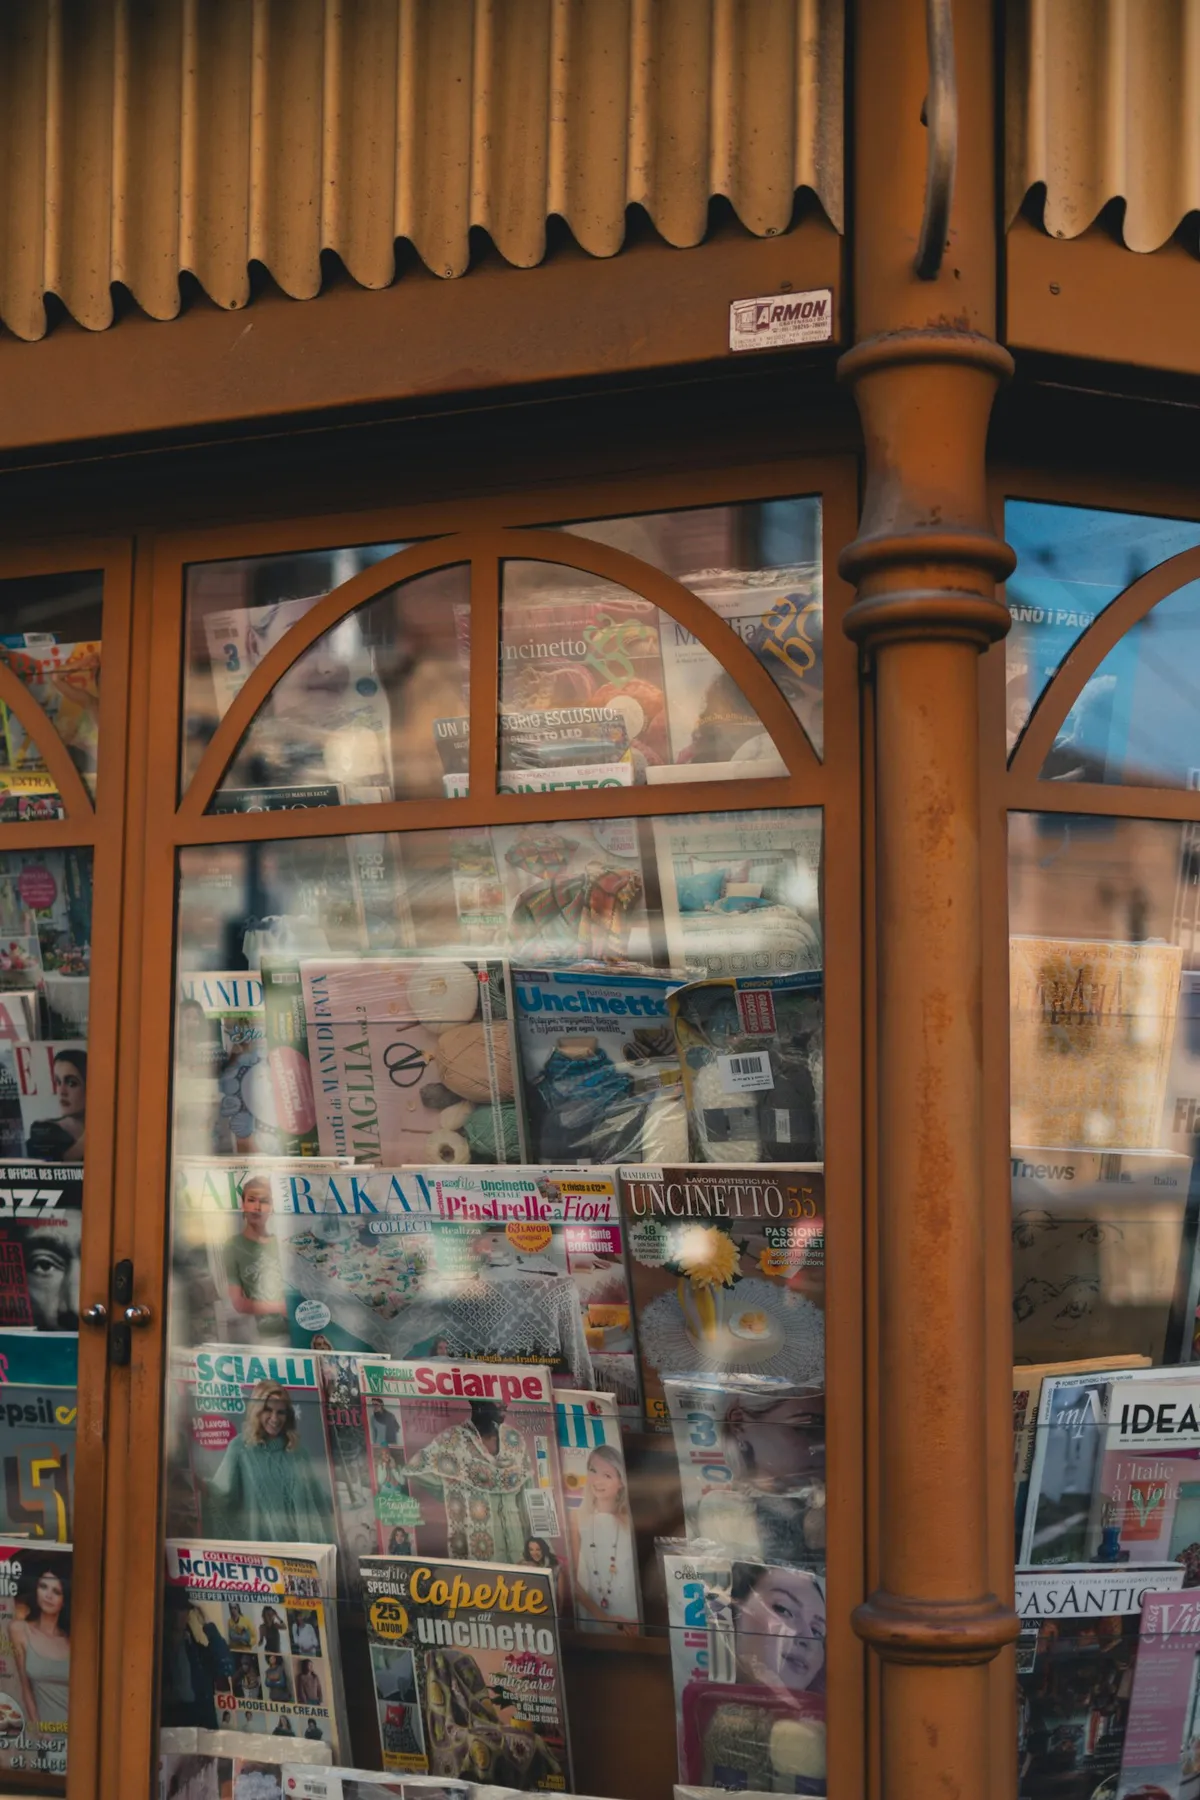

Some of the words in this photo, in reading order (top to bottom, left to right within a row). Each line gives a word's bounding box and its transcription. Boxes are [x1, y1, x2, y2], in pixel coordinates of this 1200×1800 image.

[437, 722, 459, 738] UN
[310, 973, 332, 1018] FATA
[317, 1046, 340, 1093] MANI
[342, 1038, 384, 1166] MAGLIA
[8, 1167, 38, 1180] OFFICIEL
[38, 1168, 53, 1181] DES
[717, 1177, 761, 1185] ARTISTICI
[480, 1180, 536, 1193] Uncinetto
[445, 1196, 553, 1223] Piastrelle
[563, 1195, 612, 1223] Fiori
[628, 1183, 784, 1218] UNCINETTO
[787, 1187, 817, 1219] 55
[764, 1226, 824, 1237] PASSIONE
[567, 1241, 615, 1253] BORDURE
[771, 1237, 825, 1249] CROCHET
[195, 1353, 317, 1386] SCIALLI
[197, 1382, 241, 1398] SCIARPE
[414, 1367, 543, 1403] Sciarpe
[196, 1397, 245, 1413] PONCHO
[1115, 1464, 1175, 1481] L'Italie
[1111, 1487, 1122, 1502] à
[203, 1551, 263, 1565] COLLECTION
[187, 1571, 271, 1593] indossato
[367, 1580, 407, 1596] SPECIALE
[206, 1592, 222, 1601] PER
[223, 1593, 250, 1602] TUTTO
[250, 1595, 280, 1604] L'ANNO
[409, 1567, 550, 1619] Coperte
[375, 1602, 401, 1621] 25
[683, 1582, 708, 1628] 2
[375, 1621, 403, 1634] LAVORI
[416, 1616, 556, 1656] uncinetto
[502, 1661, 536, 1676] Facili
[538, 1663, 555, 1677] da
[502, 1691, 519, 1701] Crea
[216, 1695, 237, 1710] 60
[238, 1700, 280, 1713] MODELLI
[280, 1702, 292, 1714] da
[292, 1706, 330, 1718] CREARE
[535, 1704, 558, 1715] valore
[540, 1715, 560, 1725] casa
[10, 1754, 26, 1768] et
